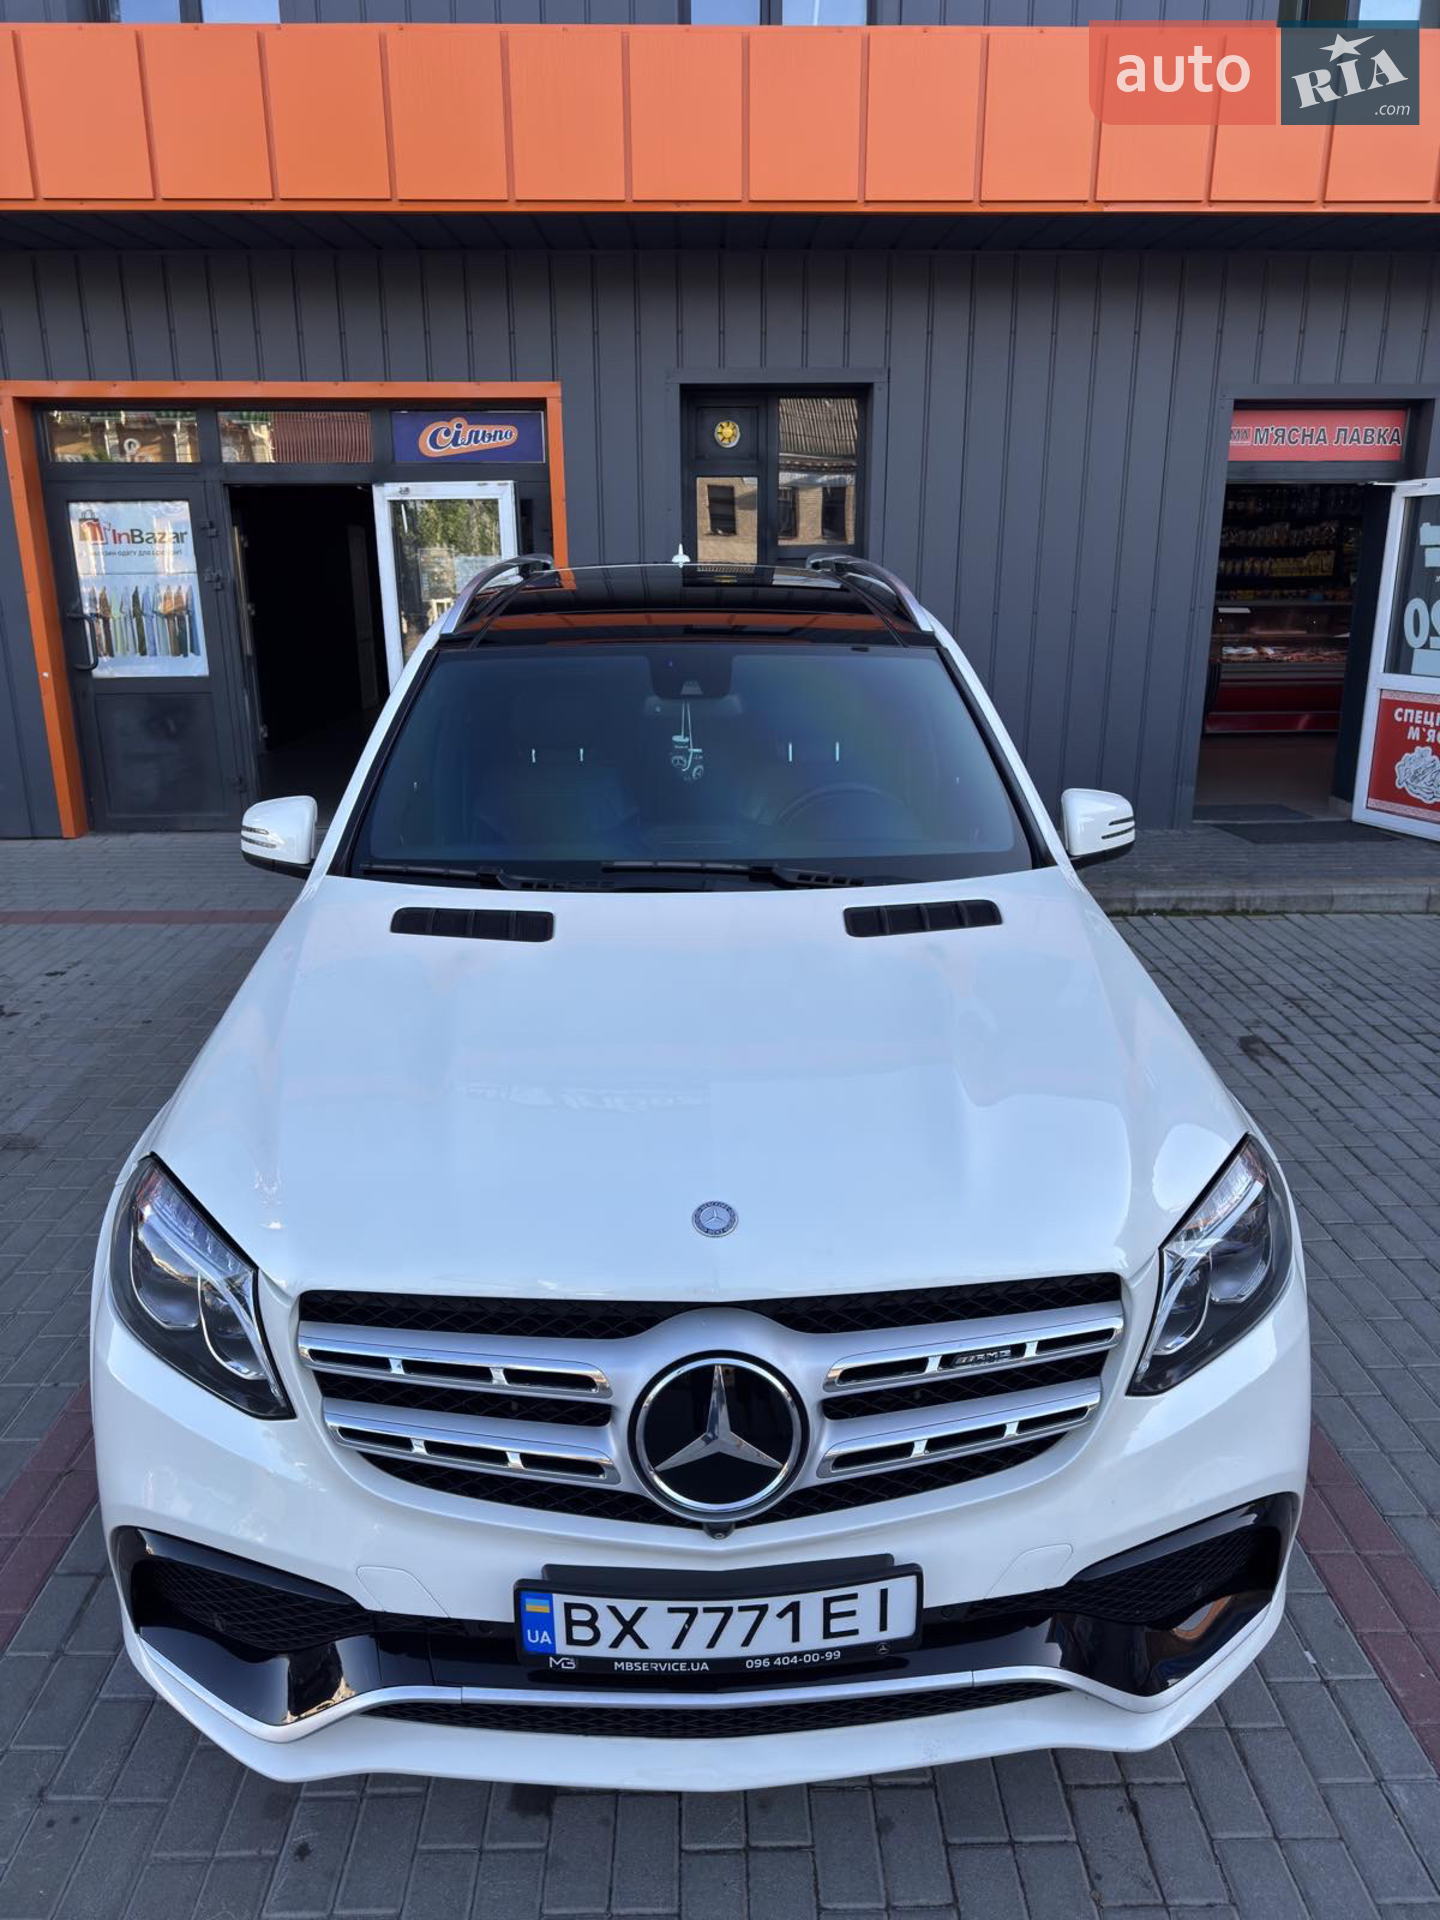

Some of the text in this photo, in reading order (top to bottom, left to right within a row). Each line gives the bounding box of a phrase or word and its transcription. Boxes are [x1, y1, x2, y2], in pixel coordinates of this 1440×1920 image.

[427, 421, 513, 452] Сільпо
[1333, 426, 1402, 446] ЛАВКА
[111, 528, 188, 545] InBazar
[563, 1601, 649, 1650] BX
[667, 1600, 801, 1650] 7771
[527, 1630, 552, 1645] UA
[613, 1650, 842, 1672] MBSERVICE.UA 096 404-00-99
